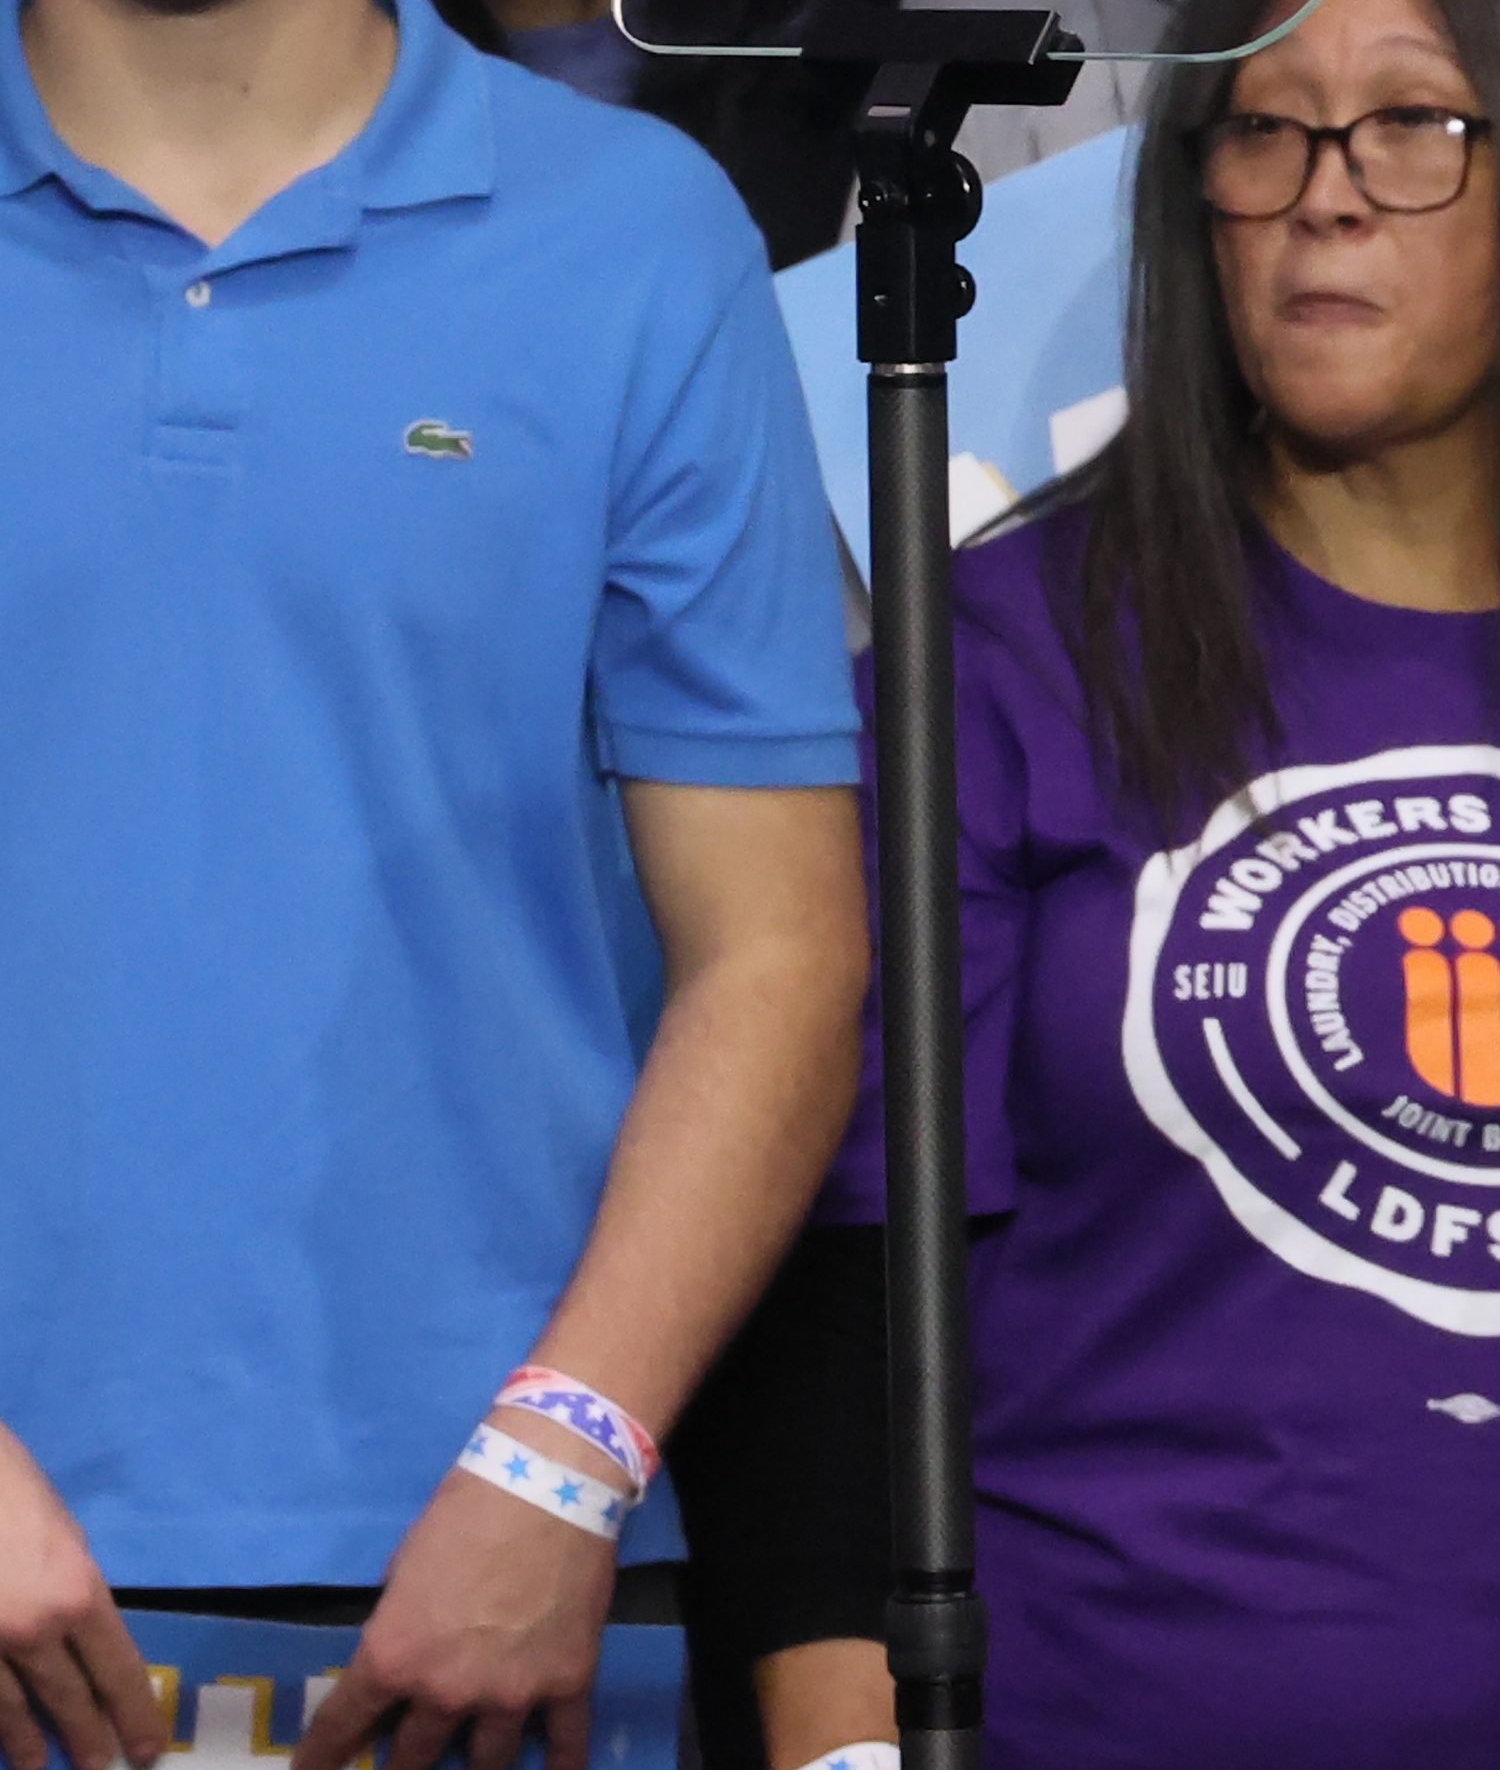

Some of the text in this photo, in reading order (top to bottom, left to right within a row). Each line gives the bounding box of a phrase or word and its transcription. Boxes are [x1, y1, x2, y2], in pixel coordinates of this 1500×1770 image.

[1199, 794, 1491, 930] WORKERS
[1173, 962, 1248, 1000] SEIU
[1305, 934, 1363, 1071] LAUNDRY,
[1381, 1094, 1474, 1148] JOINT
